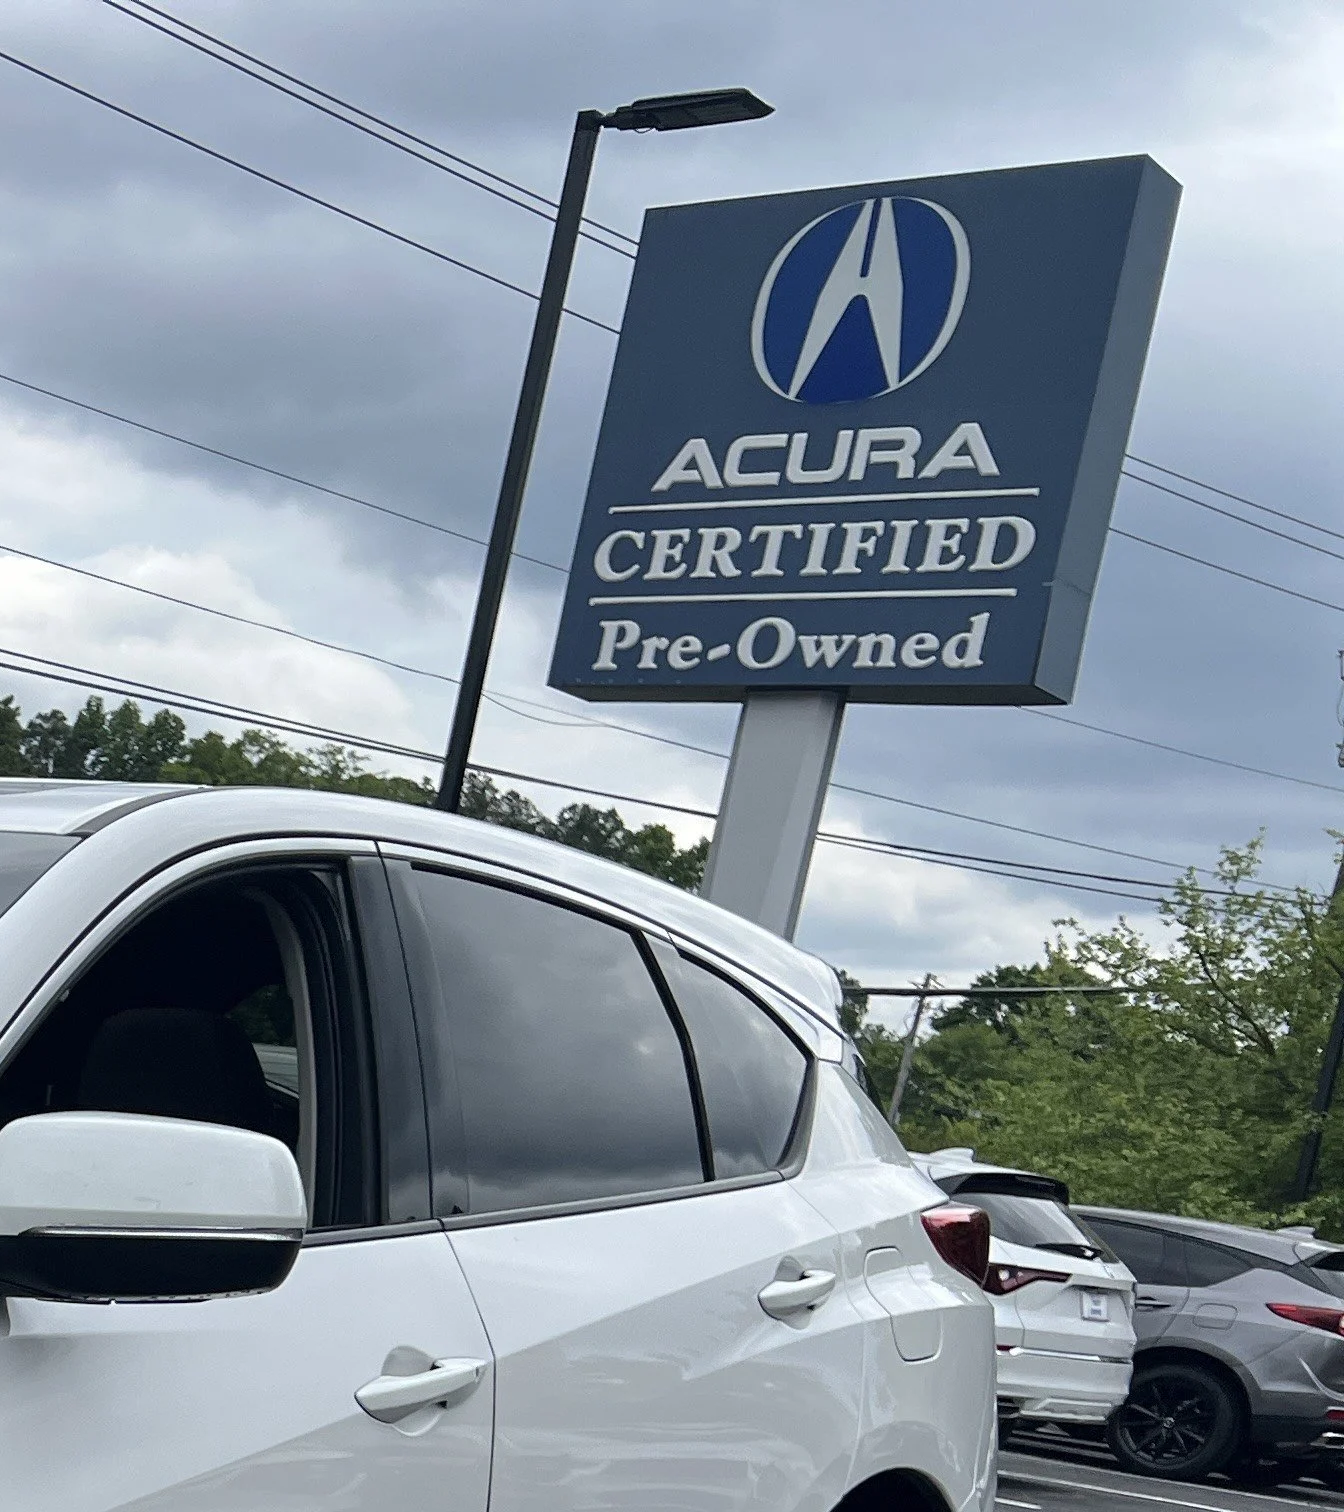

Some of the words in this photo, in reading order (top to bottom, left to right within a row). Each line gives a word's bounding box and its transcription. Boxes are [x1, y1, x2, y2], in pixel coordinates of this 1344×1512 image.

[650, 422, 1001, 493] ACURA
[592, 515, 1037, 583] CERTIFIED
[591, 611, 991, 671] Pre-Owned
